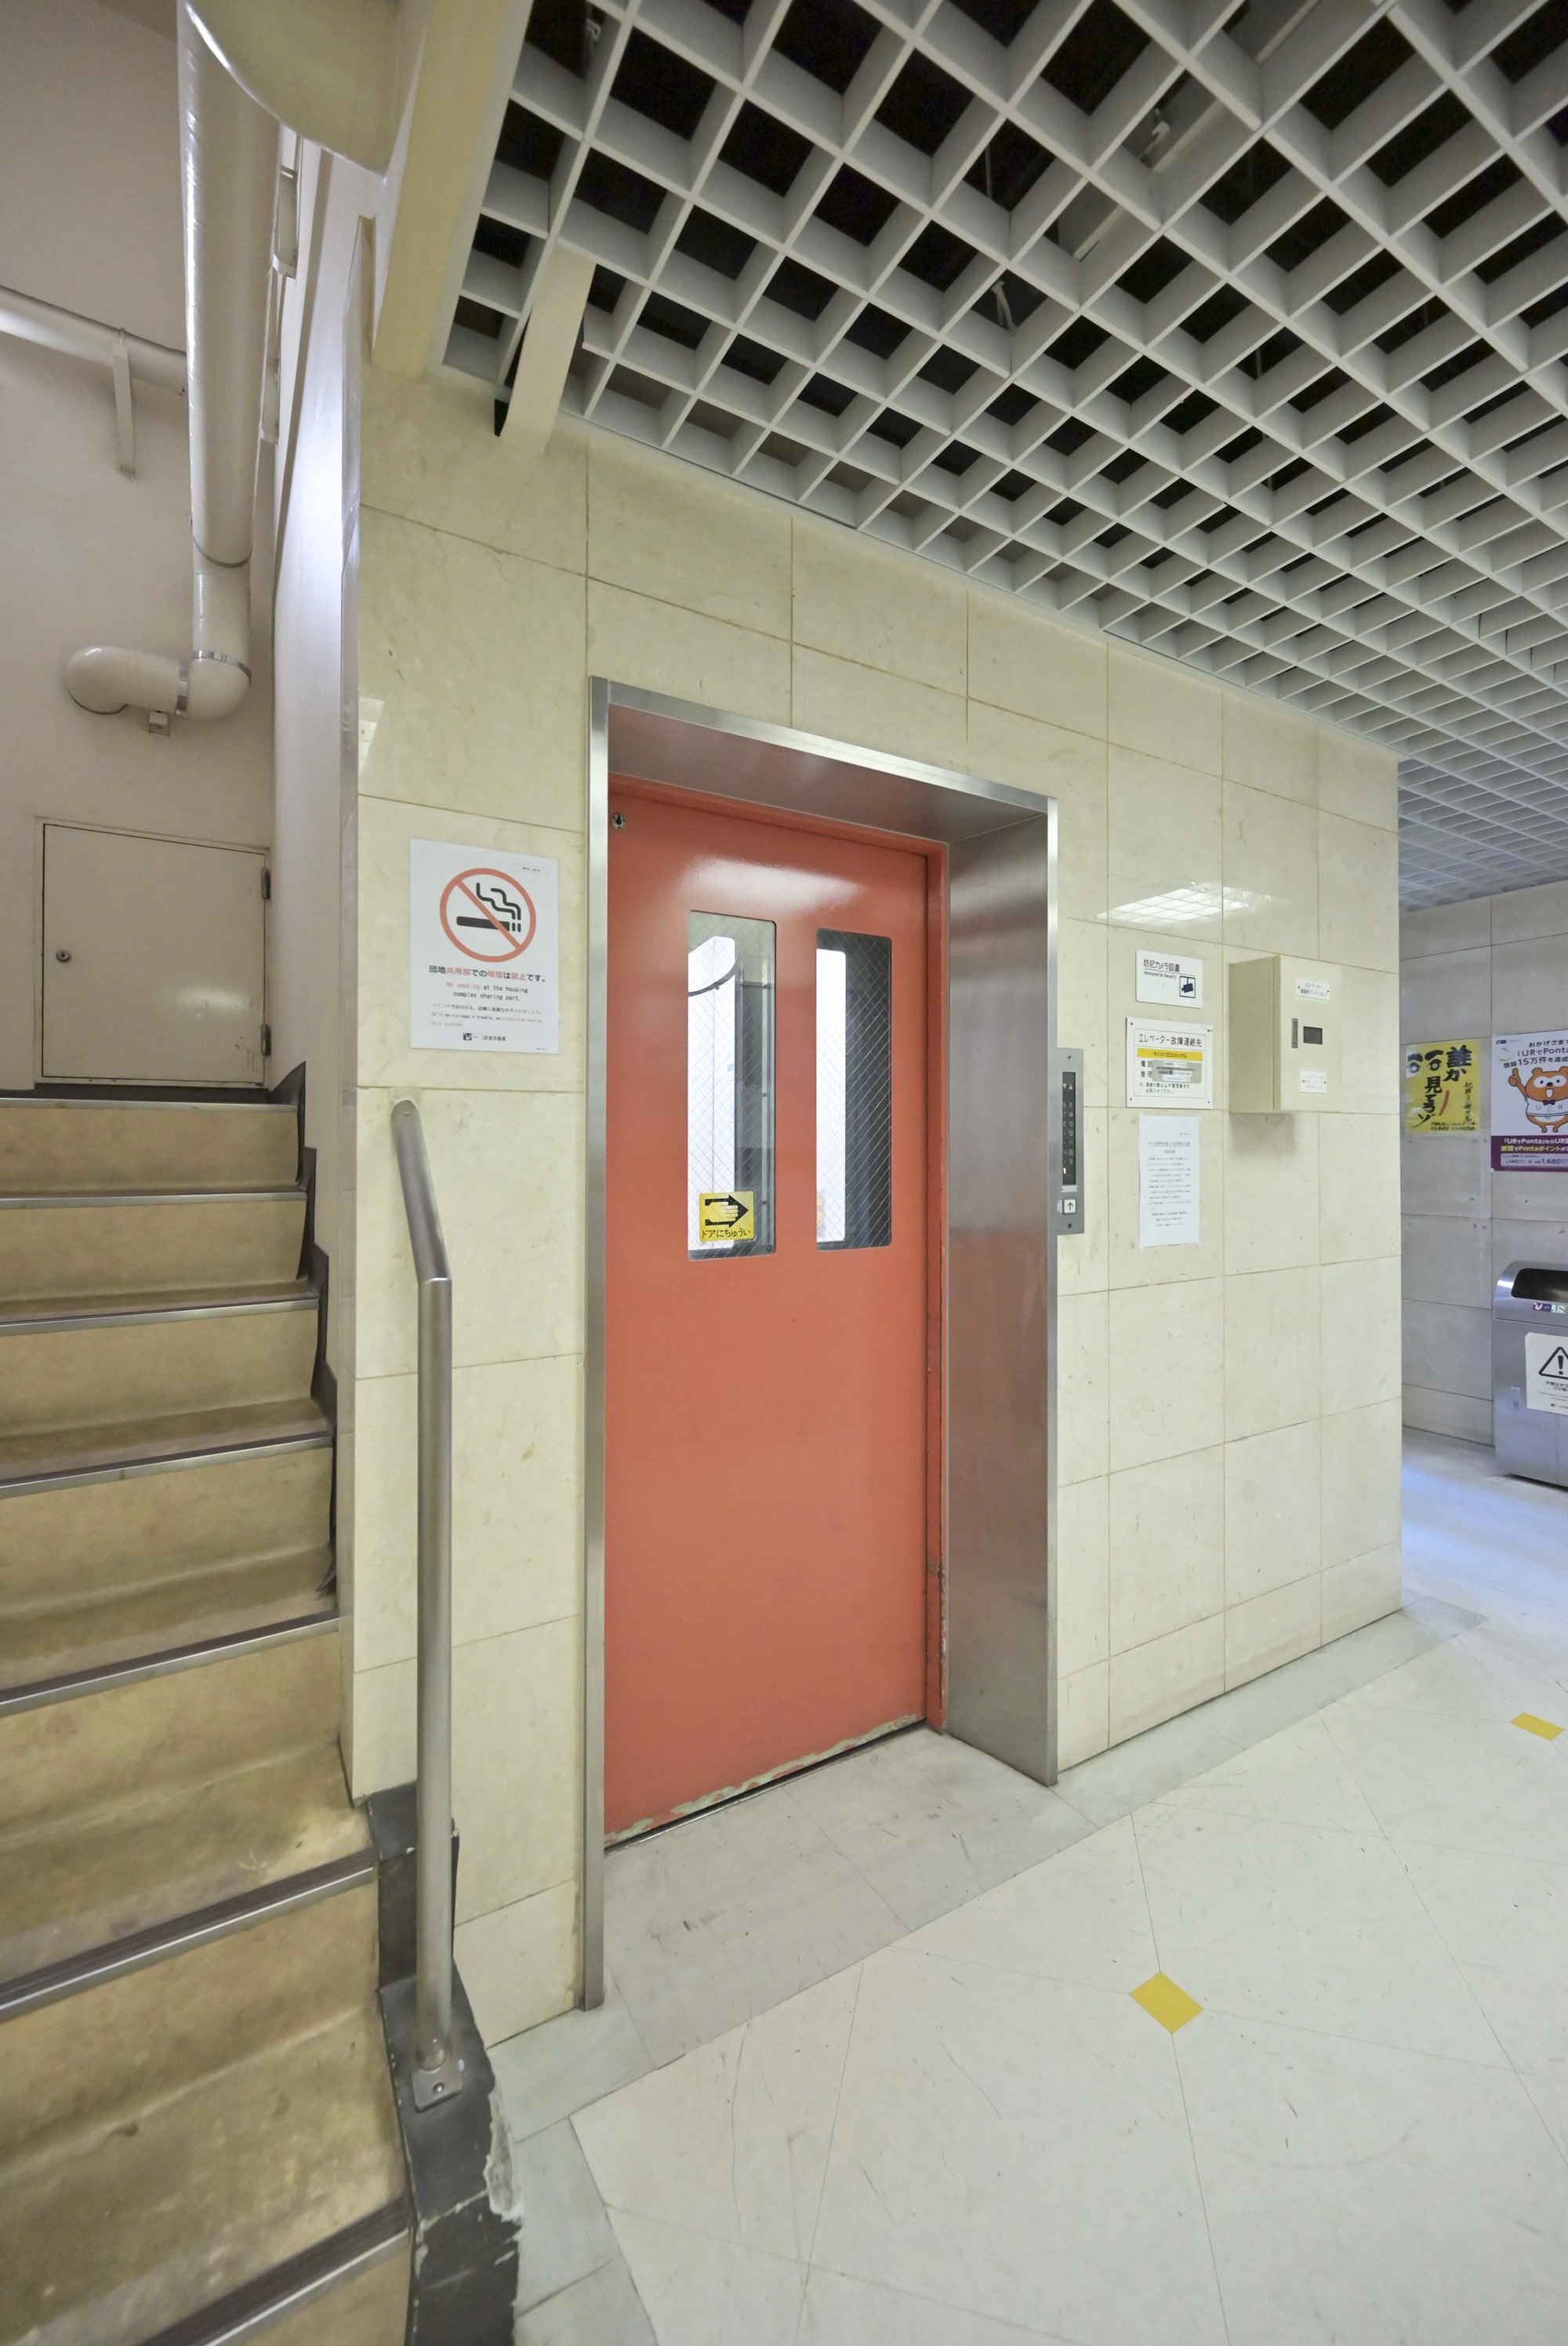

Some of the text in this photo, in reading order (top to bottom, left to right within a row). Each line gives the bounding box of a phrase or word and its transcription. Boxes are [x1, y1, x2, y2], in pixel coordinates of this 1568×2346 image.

[1144, 958, 1180, 973] 防犯カメラ設置
[1138, 1033, 1203, 1048] エレベーター故障連絡先
[702, 1227, 751, 1239] ドアにちゅうい
